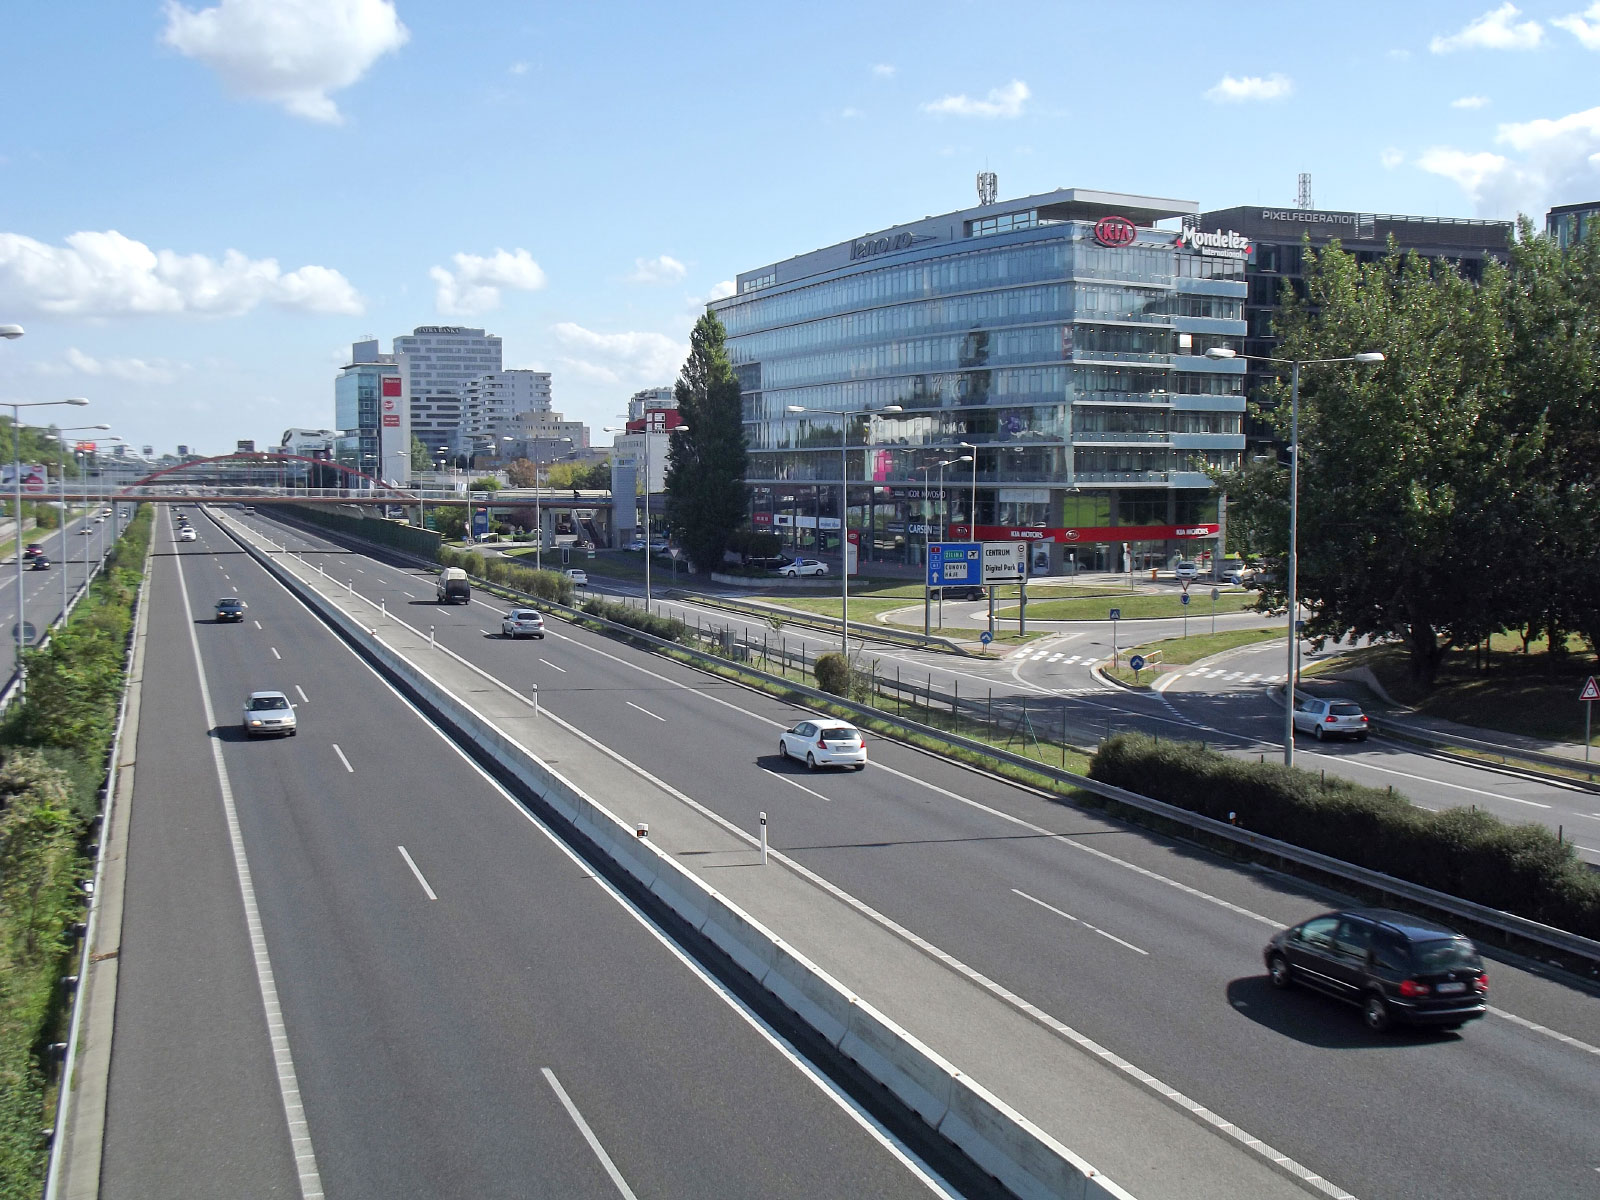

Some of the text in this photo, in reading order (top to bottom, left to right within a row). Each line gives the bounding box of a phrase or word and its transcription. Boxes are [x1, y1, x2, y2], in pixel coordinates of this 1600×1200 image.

[1262, 210, 1357, 224] PIXELFEDERATION
[1102, 223, 1130, 241] KIA
[1182, 226, 1249, 249] Mondelēz
[850, 232, 912, 260] lenovo
[1202, 247, 1242, 258] International
[985, 564, 1003, 573] Digital
